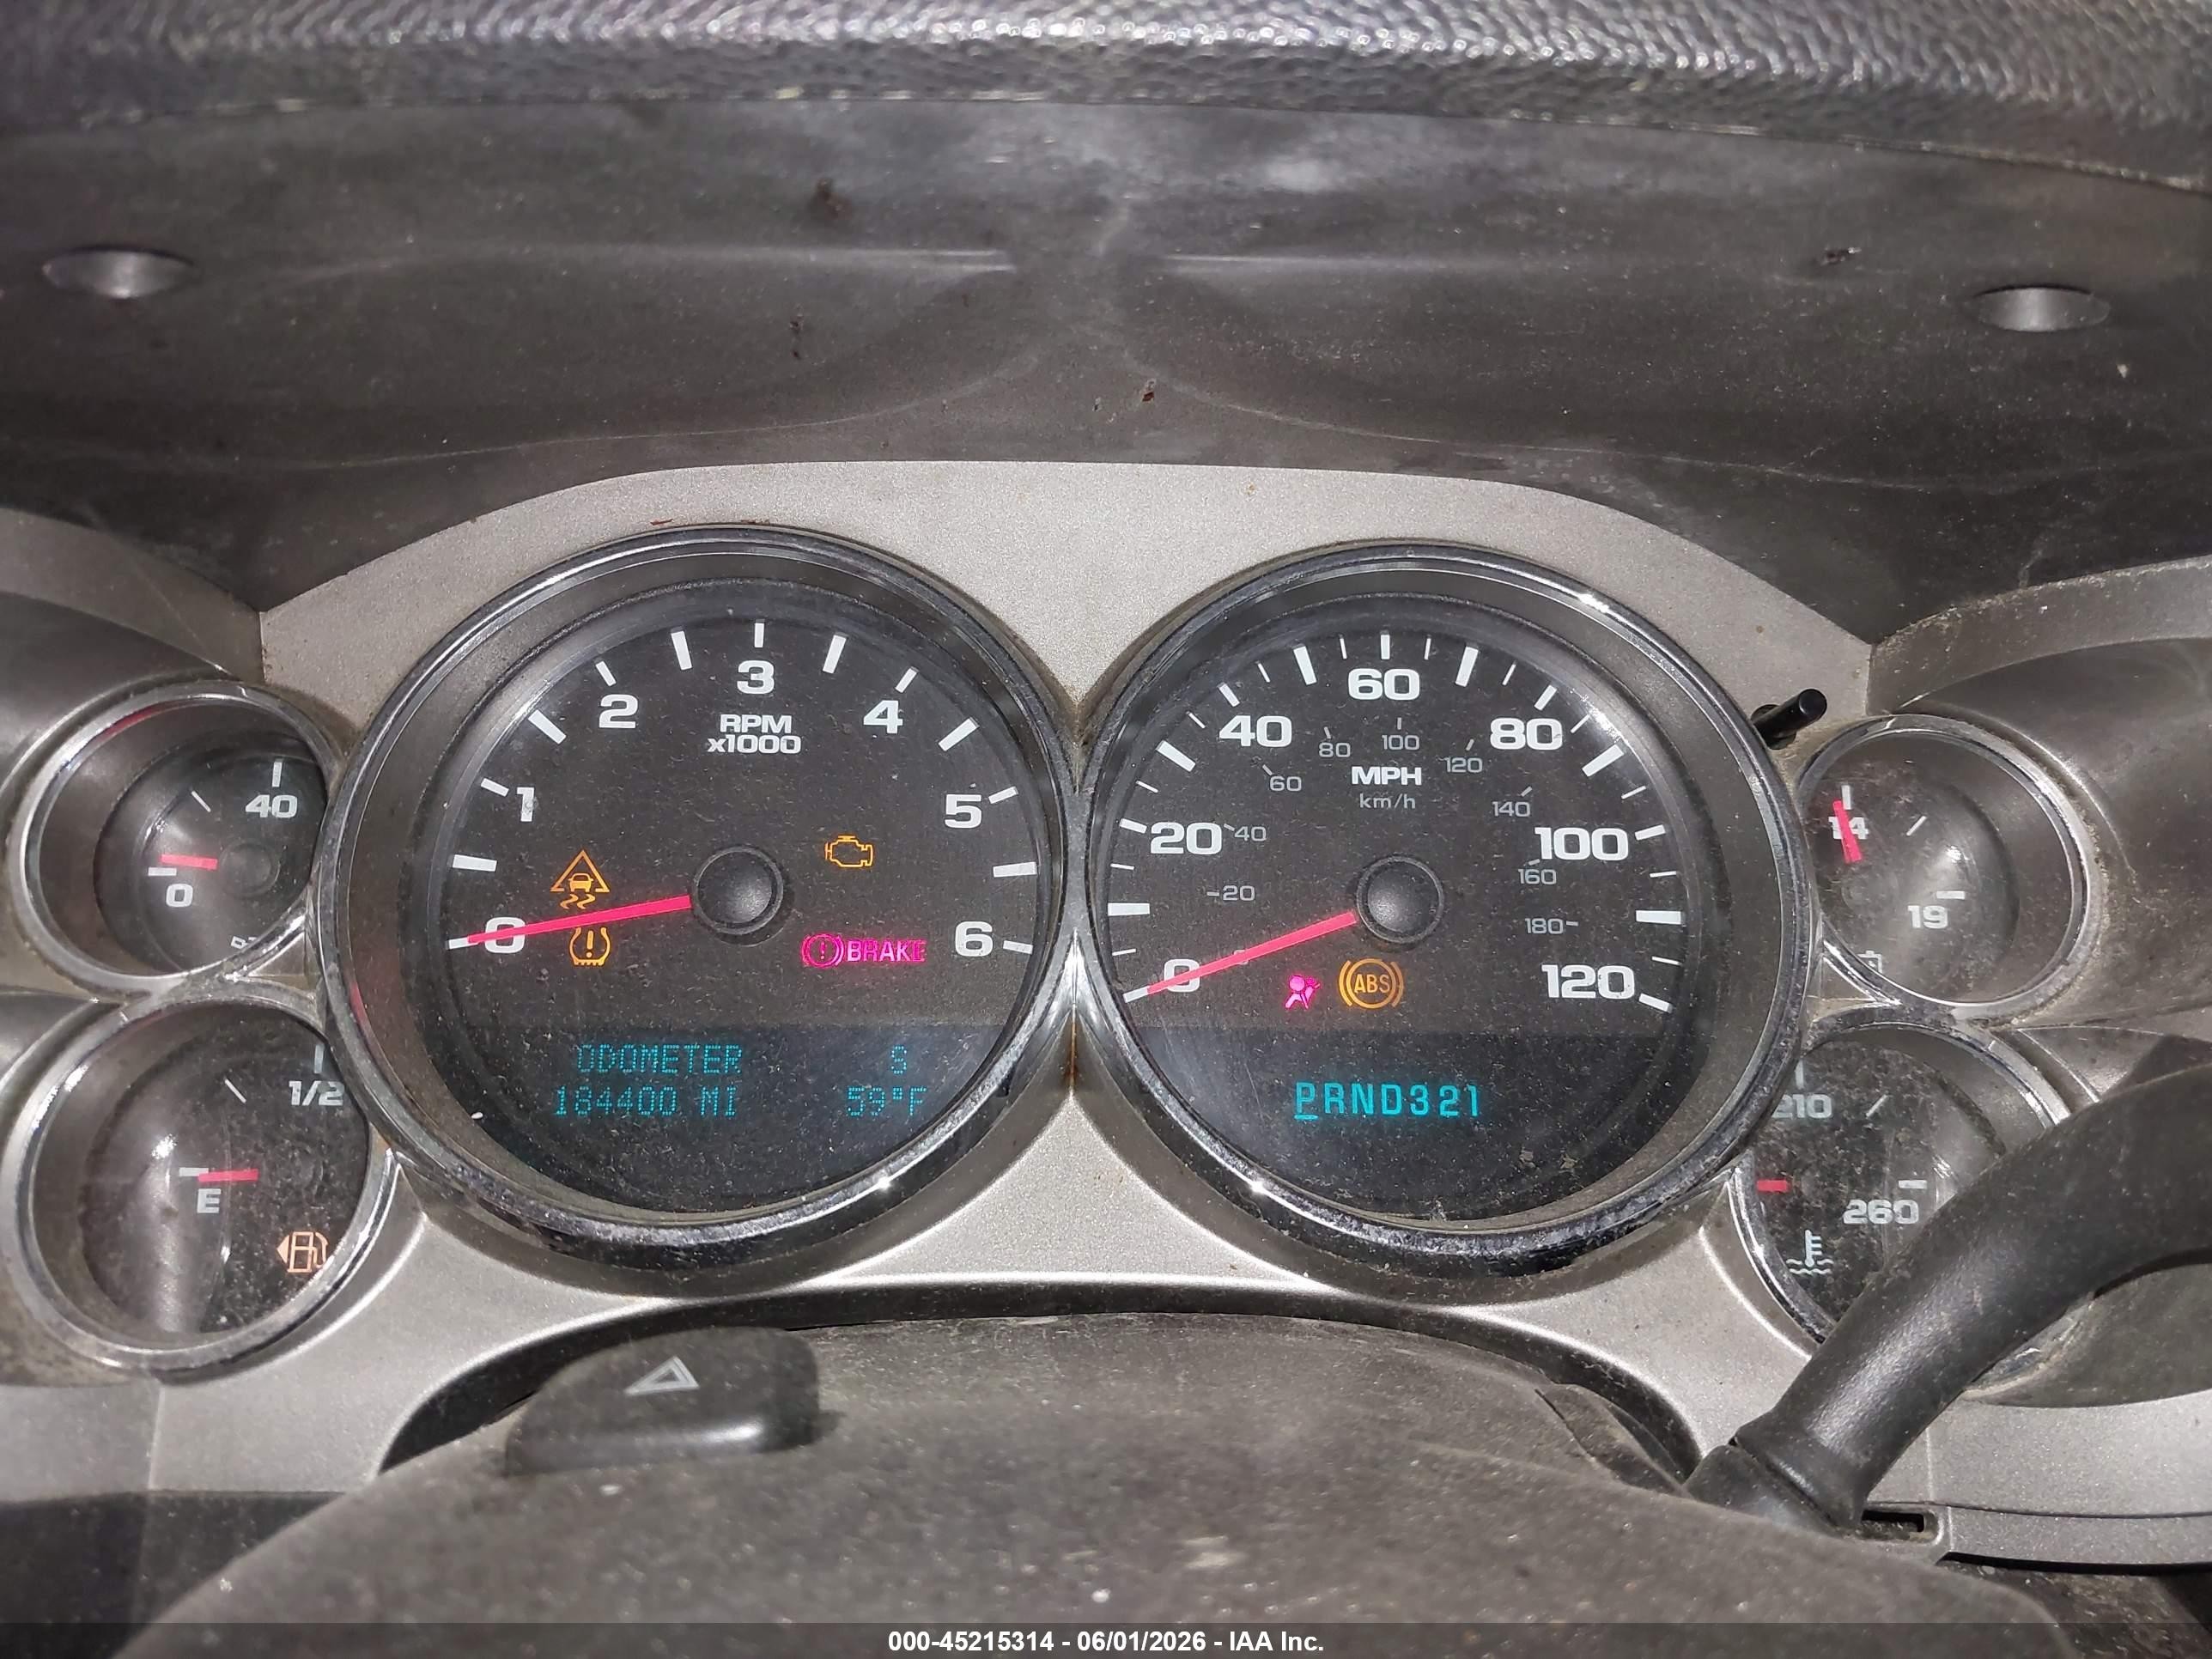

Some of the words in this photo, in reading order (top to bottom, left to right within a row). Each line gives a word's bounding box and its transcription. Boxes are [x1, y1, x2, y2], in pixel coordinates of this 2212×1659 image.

[737, 660, 775, 695] 3
[1348, 668, 1419, 701] 60
[599, 694, 639, 729] 2
[863, 700, 903, 734] 4
[720, 714, 792, 734] RPM
[1219, 715, 1292, 747] 40
[1490, 718, 1563, 750] 80
[708, 735, 801, 754] x1000
[1318, 742, 1351, 757] 80
[1382, 735, 1419, 750] 100
[1352, 766, 1422, 785] MPH
[1444, 757, 1483, 773] 120
[1269, 776, 1302, 792] 60
[246, 794, 298, 818] 40
[517, 787, 534, 822] 1
[945, 793, 982, 829] 5
[1359, 793, 1415, 809] km/h
[1492, 801, 1530, 817] 140
[1151, 822, 1222, 854] 20
[1234, 826, 1267, 842] 40
[1828, 816, 1869, 840] 14
[1534, 827, 1629, 860] 100
[1518, 869, 1557, 884] 160
[166, 884, 193, 908] 0
[1223, 885, 1255, 901] 20
[1525, 918, 1564, 934] 180
[1907, 905, 1948, 929] 19
[485, 917, 526, 953] 0
[955, 921, 993, 957] 6
[847, 940, 927, 963] BRAKE
[1164, 959, 1200, 992] 0
[1354, 974, 1391, 994] ABS
[1541, 964, 1635, 1000] 120
[577, 1044, 743, 1073] ODOMETER
[289, 1080, 343, 1106] 1/2
[556, 1085, 677, 1115] 184400
[701, 1085, 738, 1115] MI
[847, 1086, 927, 1116] 59°F
[1771, 1093, 1832, 1118] 210
[197, 1188, 221, 1213] E
[1843, 1200, 1919, 1224] 260
